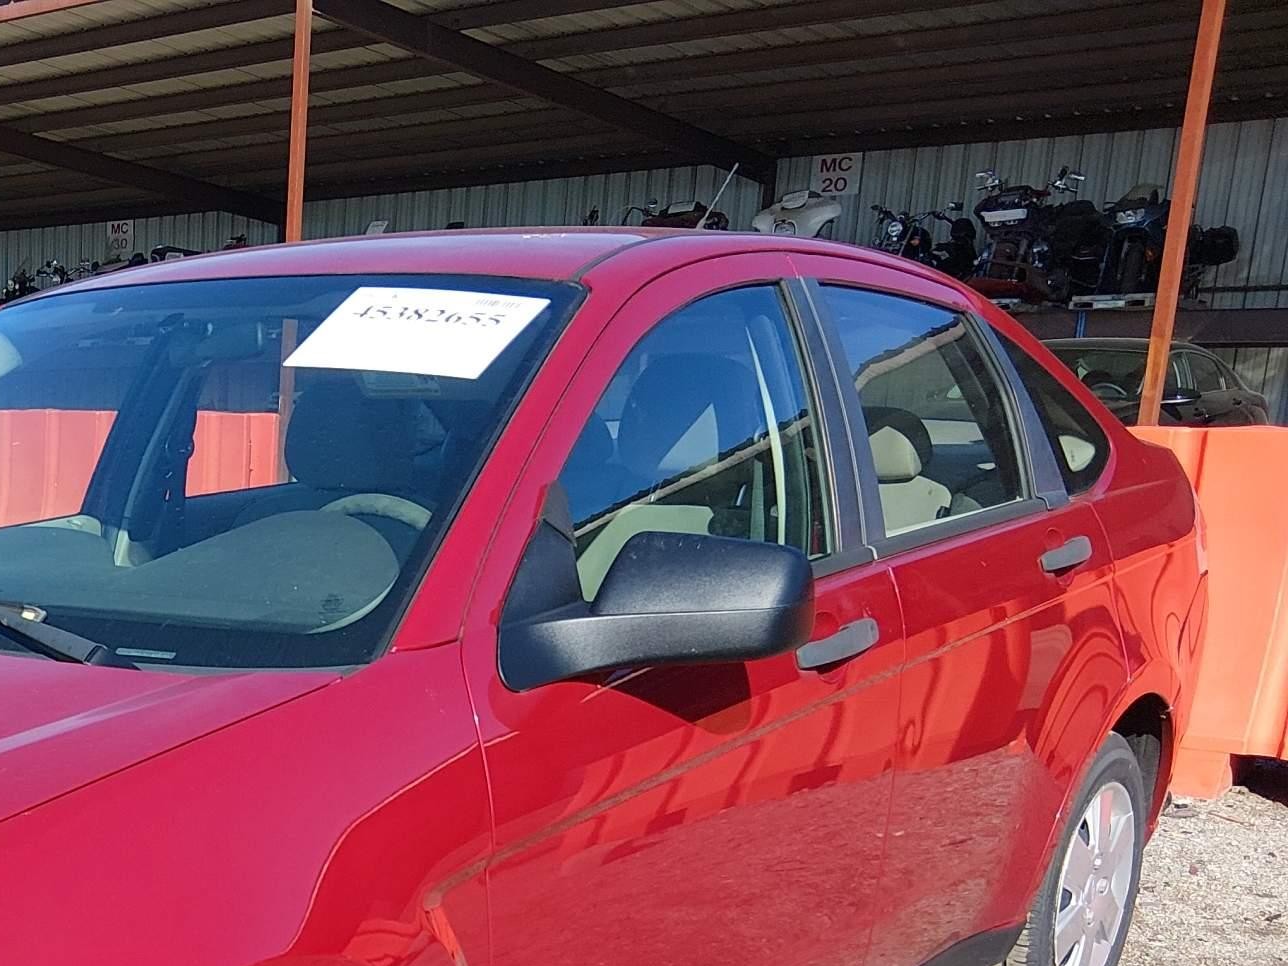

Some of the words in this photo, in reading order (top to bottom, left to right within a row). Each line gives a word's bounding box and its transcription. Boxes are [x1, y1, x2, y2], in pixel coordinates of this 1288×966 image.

[820, 157, 853, 173] MC
[822, 177, 847, 192] 20
[111, 222, 129, 234] MC
[111, 238, 128, 249] 30
[353, 305, 507, 327] 45382655
